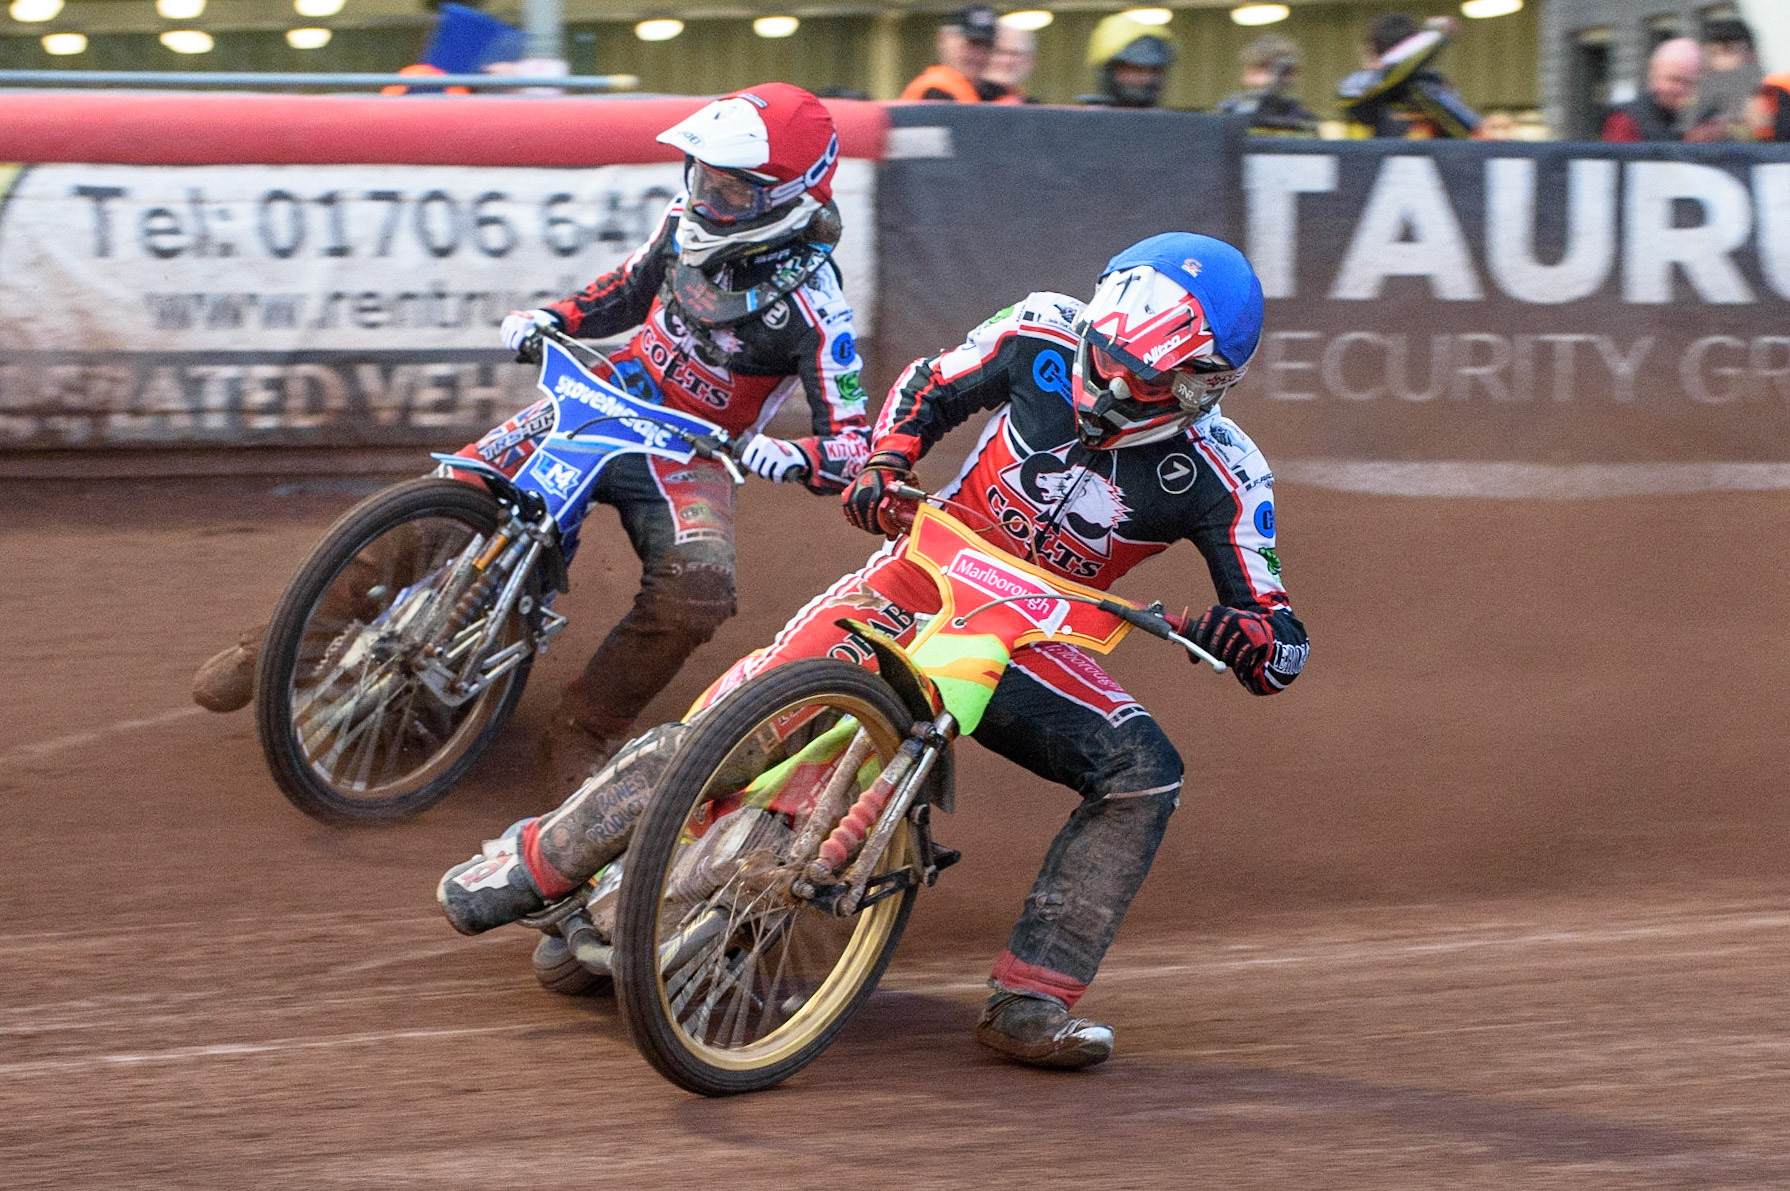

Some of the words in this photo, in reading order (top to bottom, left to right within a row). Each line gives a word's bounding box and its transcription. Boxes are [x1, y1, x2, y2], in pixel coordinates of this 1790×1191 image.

[256, 184, 518, 260] 01706
[640, 326, 732, 409] COLTS
[1262, 329, 1657, 405] ECURITY
[985, 485, 1107, 577] COLTS
